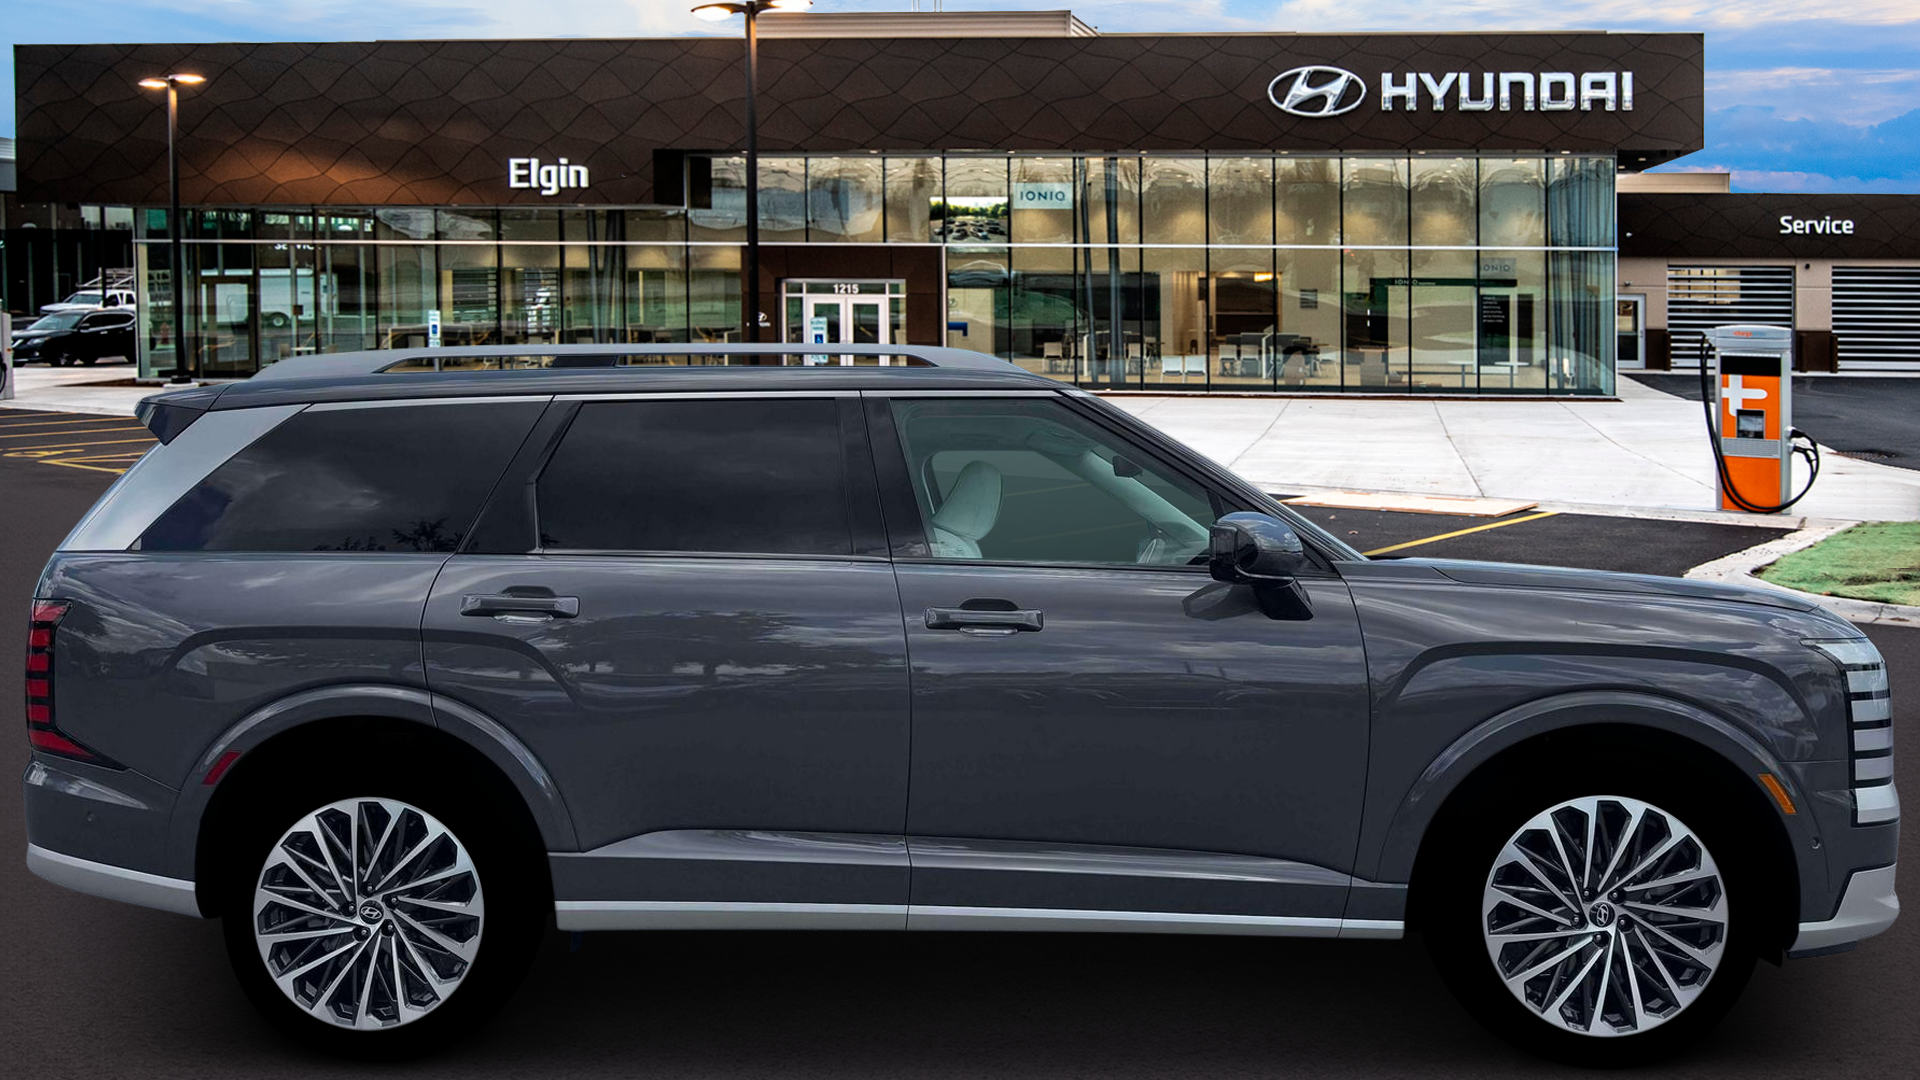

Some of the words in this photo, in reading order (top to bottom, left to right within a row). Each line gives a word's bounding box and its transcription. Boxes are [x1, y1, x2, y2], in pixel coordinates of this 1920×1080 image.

[1381, 72, 1634, 111] HYUNDAI
[508, 157, 590, 196] Elgin
[1020, 190, 1066, 201] IONIQ
[1779, 215, 1854, 235] Service
[833, 283, 859, 294] 1215
